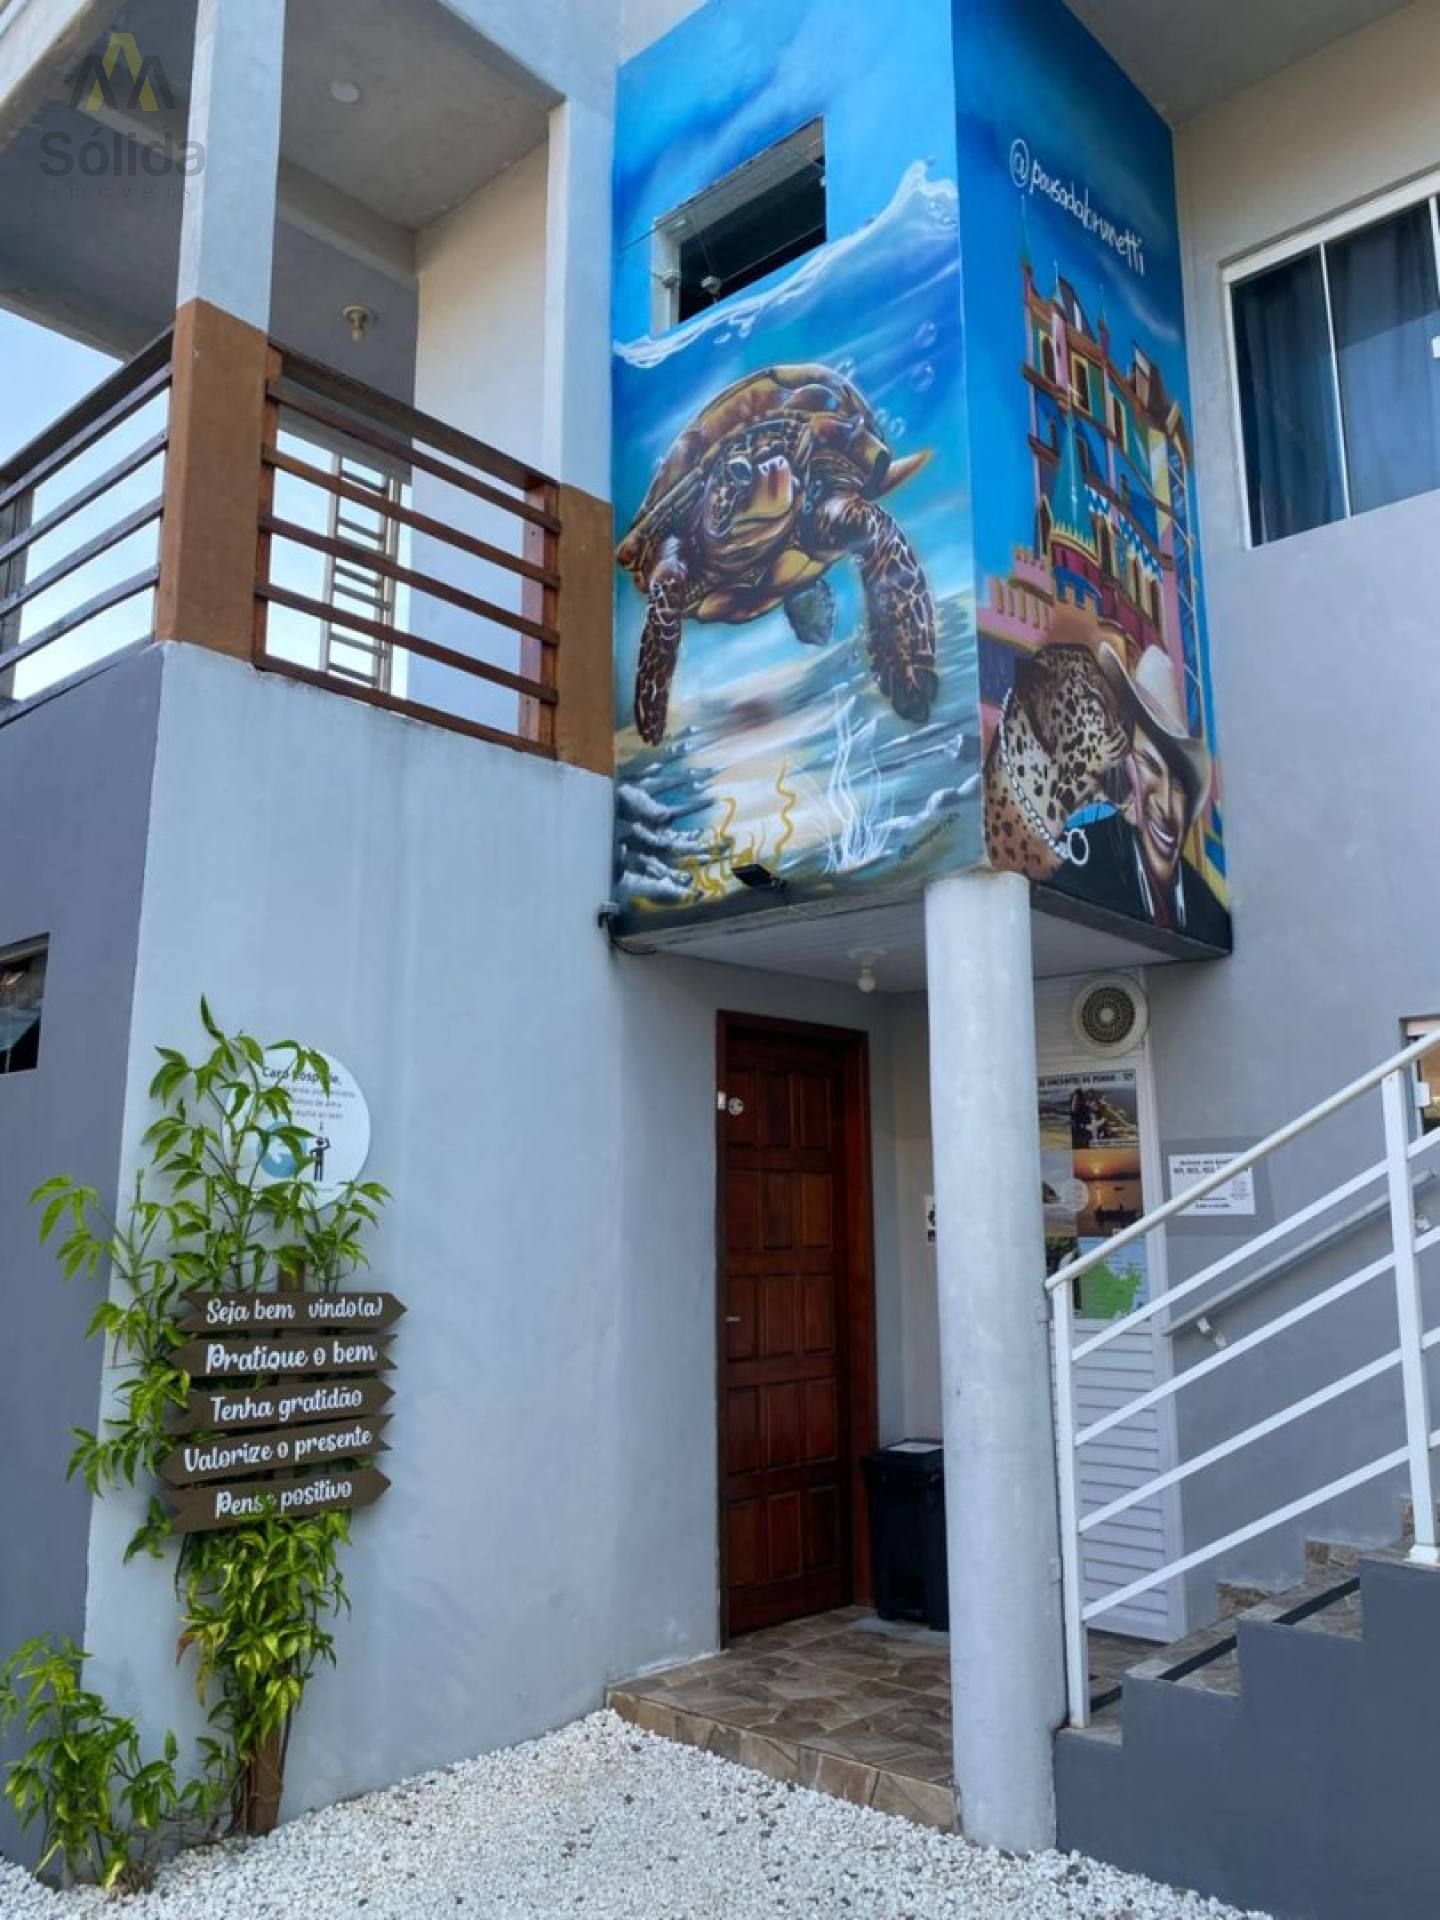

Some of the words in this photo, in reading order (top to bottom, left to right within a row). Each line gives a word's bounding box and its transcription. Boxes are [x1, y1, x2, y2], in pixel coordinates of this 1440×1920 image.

[205, 1297, 250, 1326] Seja
[253, 1299, 295, 1320] bem
[308, 1296, 383, 1319] vindo(a)
[205, 1343, 308, 1373] Pratique
[313, 1348, 326, 1366] o
[333, 1341, 377, 1364] bem
[210, 1395, 273, 1422] Tenha
[278, 1387, 362, 1422] gratidão
[183, 1442, 273, 1472] Valorize
[277, 1442, 289, 1459] o
[294, 1425, 373, 1460] presente
[280, 1479, 353, 1513] positivo
